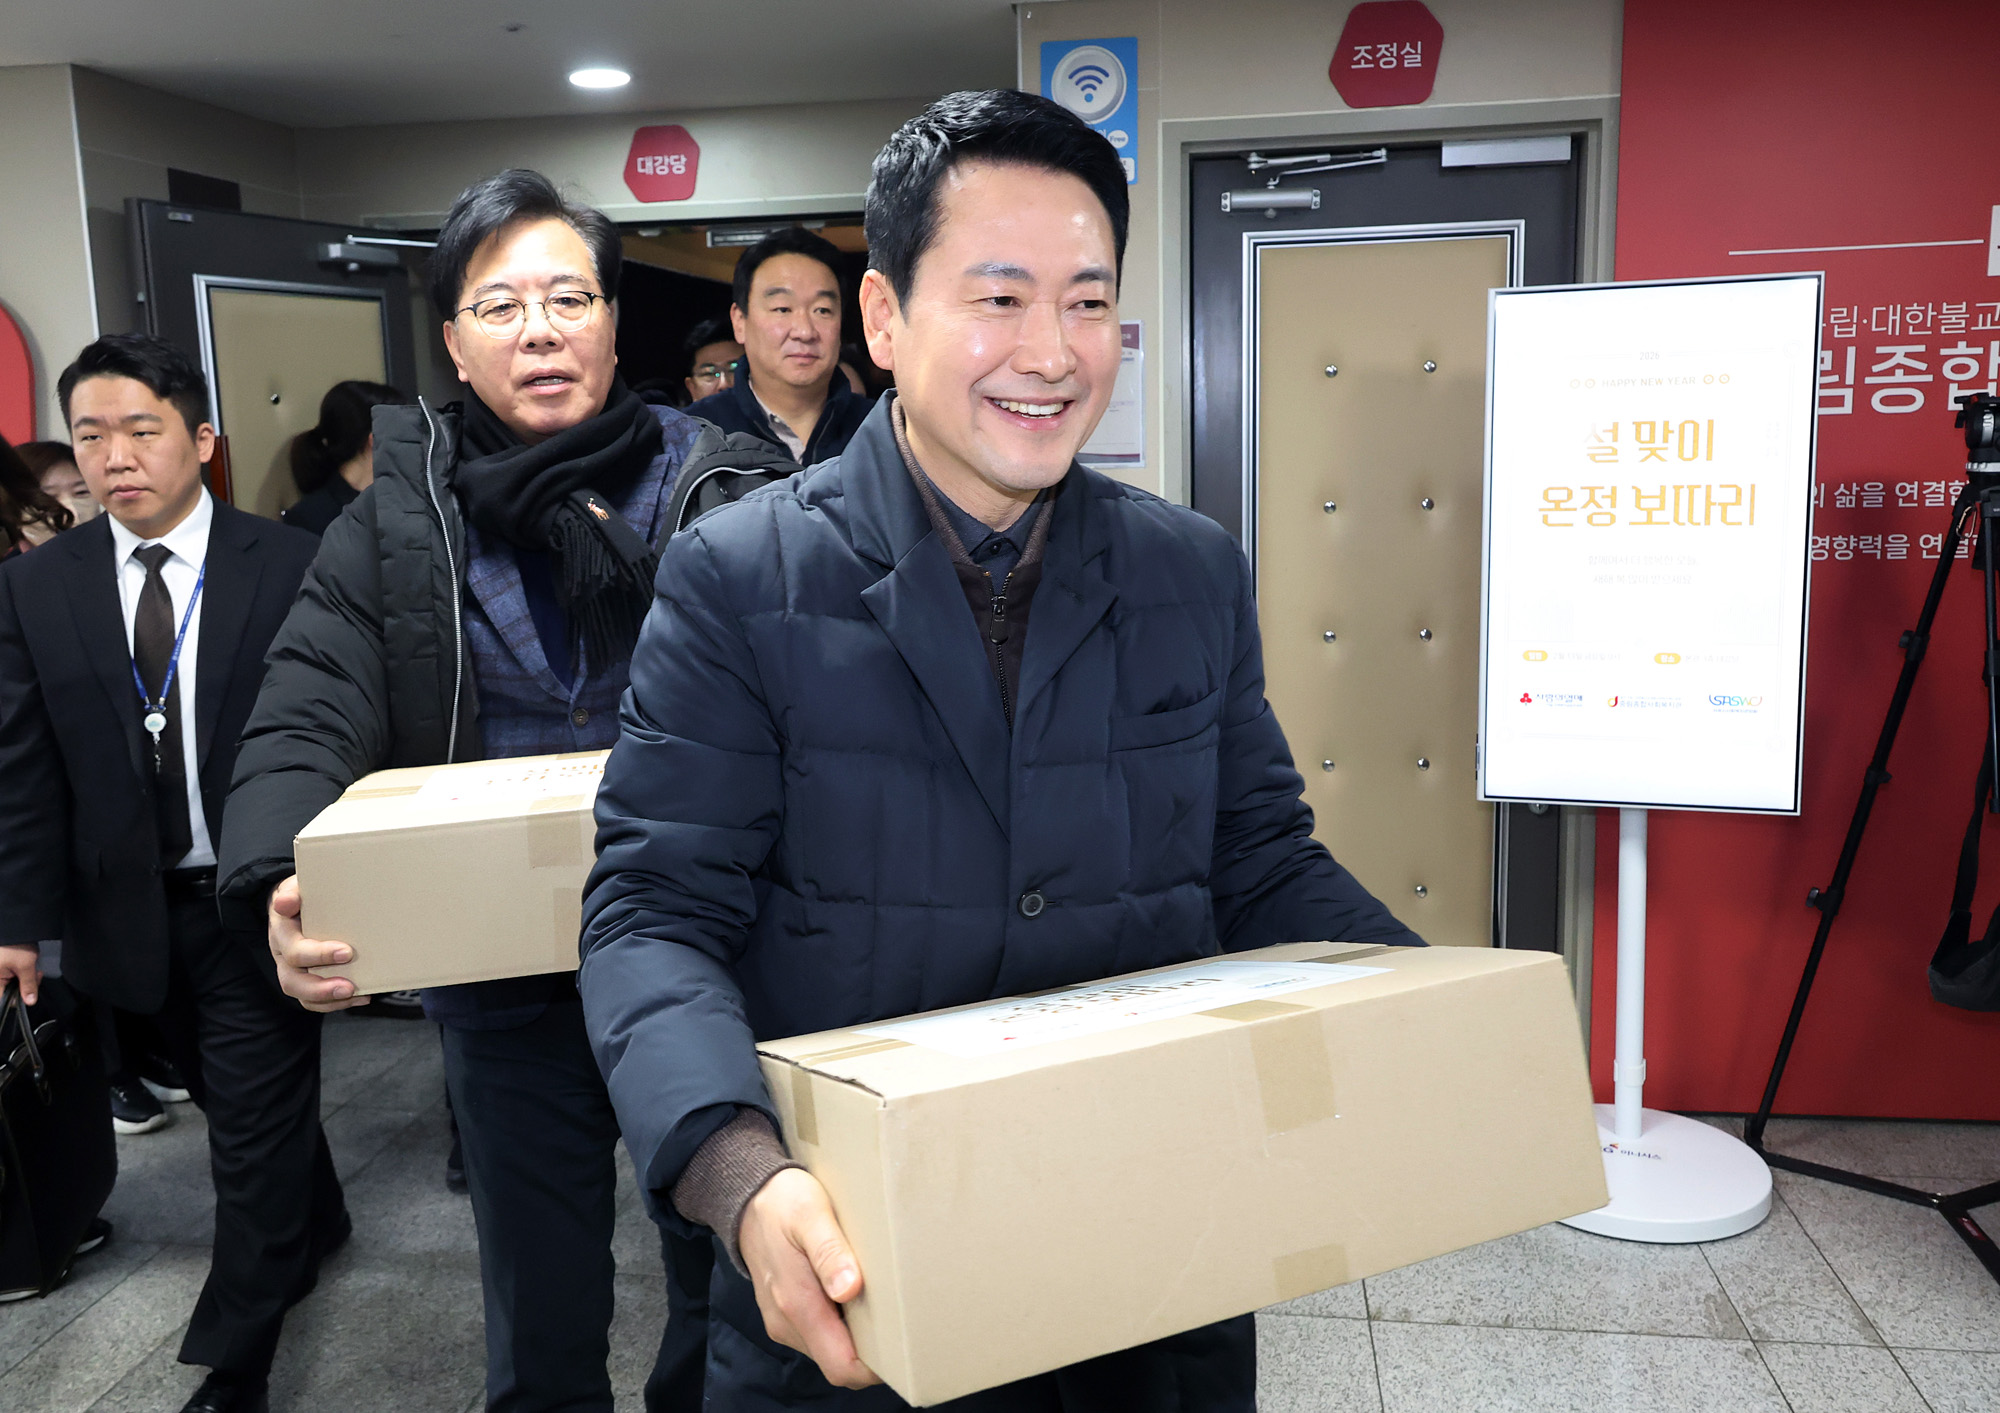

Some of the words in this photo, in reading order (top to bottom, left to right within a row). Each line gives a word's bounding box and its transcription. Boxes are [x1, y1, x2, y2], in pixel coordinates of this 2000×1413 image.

[1351, 40, 1423, 71] 조정실
[1110, 135, 1126, 143] Free
[636, 153, 686, 177] 대강당
[1823, 301, 2000, 338] 립·대한불교
[1639, 351, 1661, 361] 2026
[1602, 378, 1637, 388] HAPPY
[1640, 377, 1664, 387] NEW
[1667, 376, 1697, 386] YEAR
[1584, 421, 1620, 464] 설
[1632, 418, 1715, 463] 맞이
[1538, 484, 1617, 528] 온정
[1629, 483, 1756, 527] 보따리
[1834, 482, 1886, 508] 삶을
[1811, 533, 1910, 560] 영향력을
